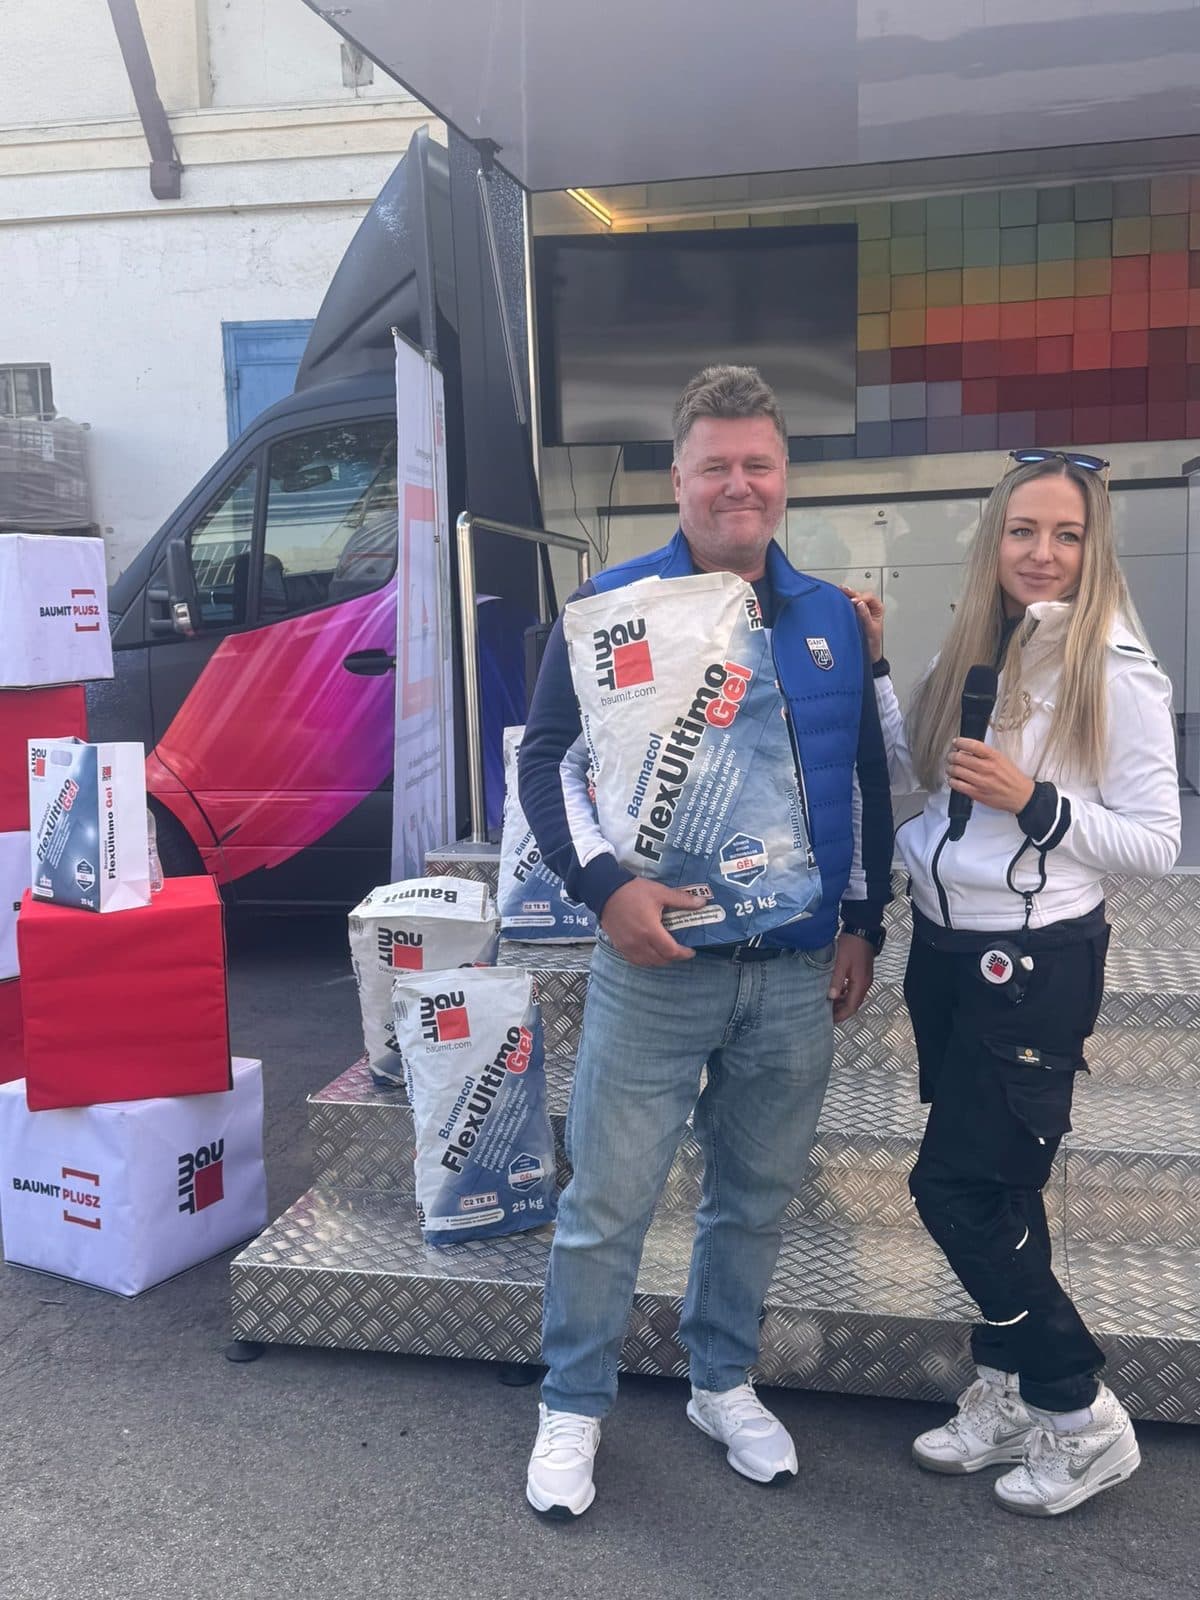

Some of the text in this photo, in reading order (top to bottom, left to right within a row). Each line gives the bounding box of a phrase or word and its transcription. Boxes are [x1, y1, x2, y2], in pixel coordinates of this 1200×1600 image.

[40, 606, 72, 617] BAUMIT
[600, 686, 656, 706] baumit.com
[634, 663, 727, 863] FlexUltimo
[704, 661, 753, 728] Gel
[627, 733, 664, 820] Baumacol
[787, 788, 801, 849] Baumacol
[734, 900, 754, 917] 25
[757, 892, 778, 910] kg
[562, 915, 574, 924] 25
[576, 915, 588, 926] kg
[425, 1040, 472, 1054] baumit.com
[439, 1075, 475, 1141] Baumacol
[442, 1026, 521, 1174] FlexUltimo
[506, 1026, 534, 1075] Gel
[13, 1177, 101, 1208] BAUMIT PLUSZ
[512, 1197, 545, 1213] 25 kg
